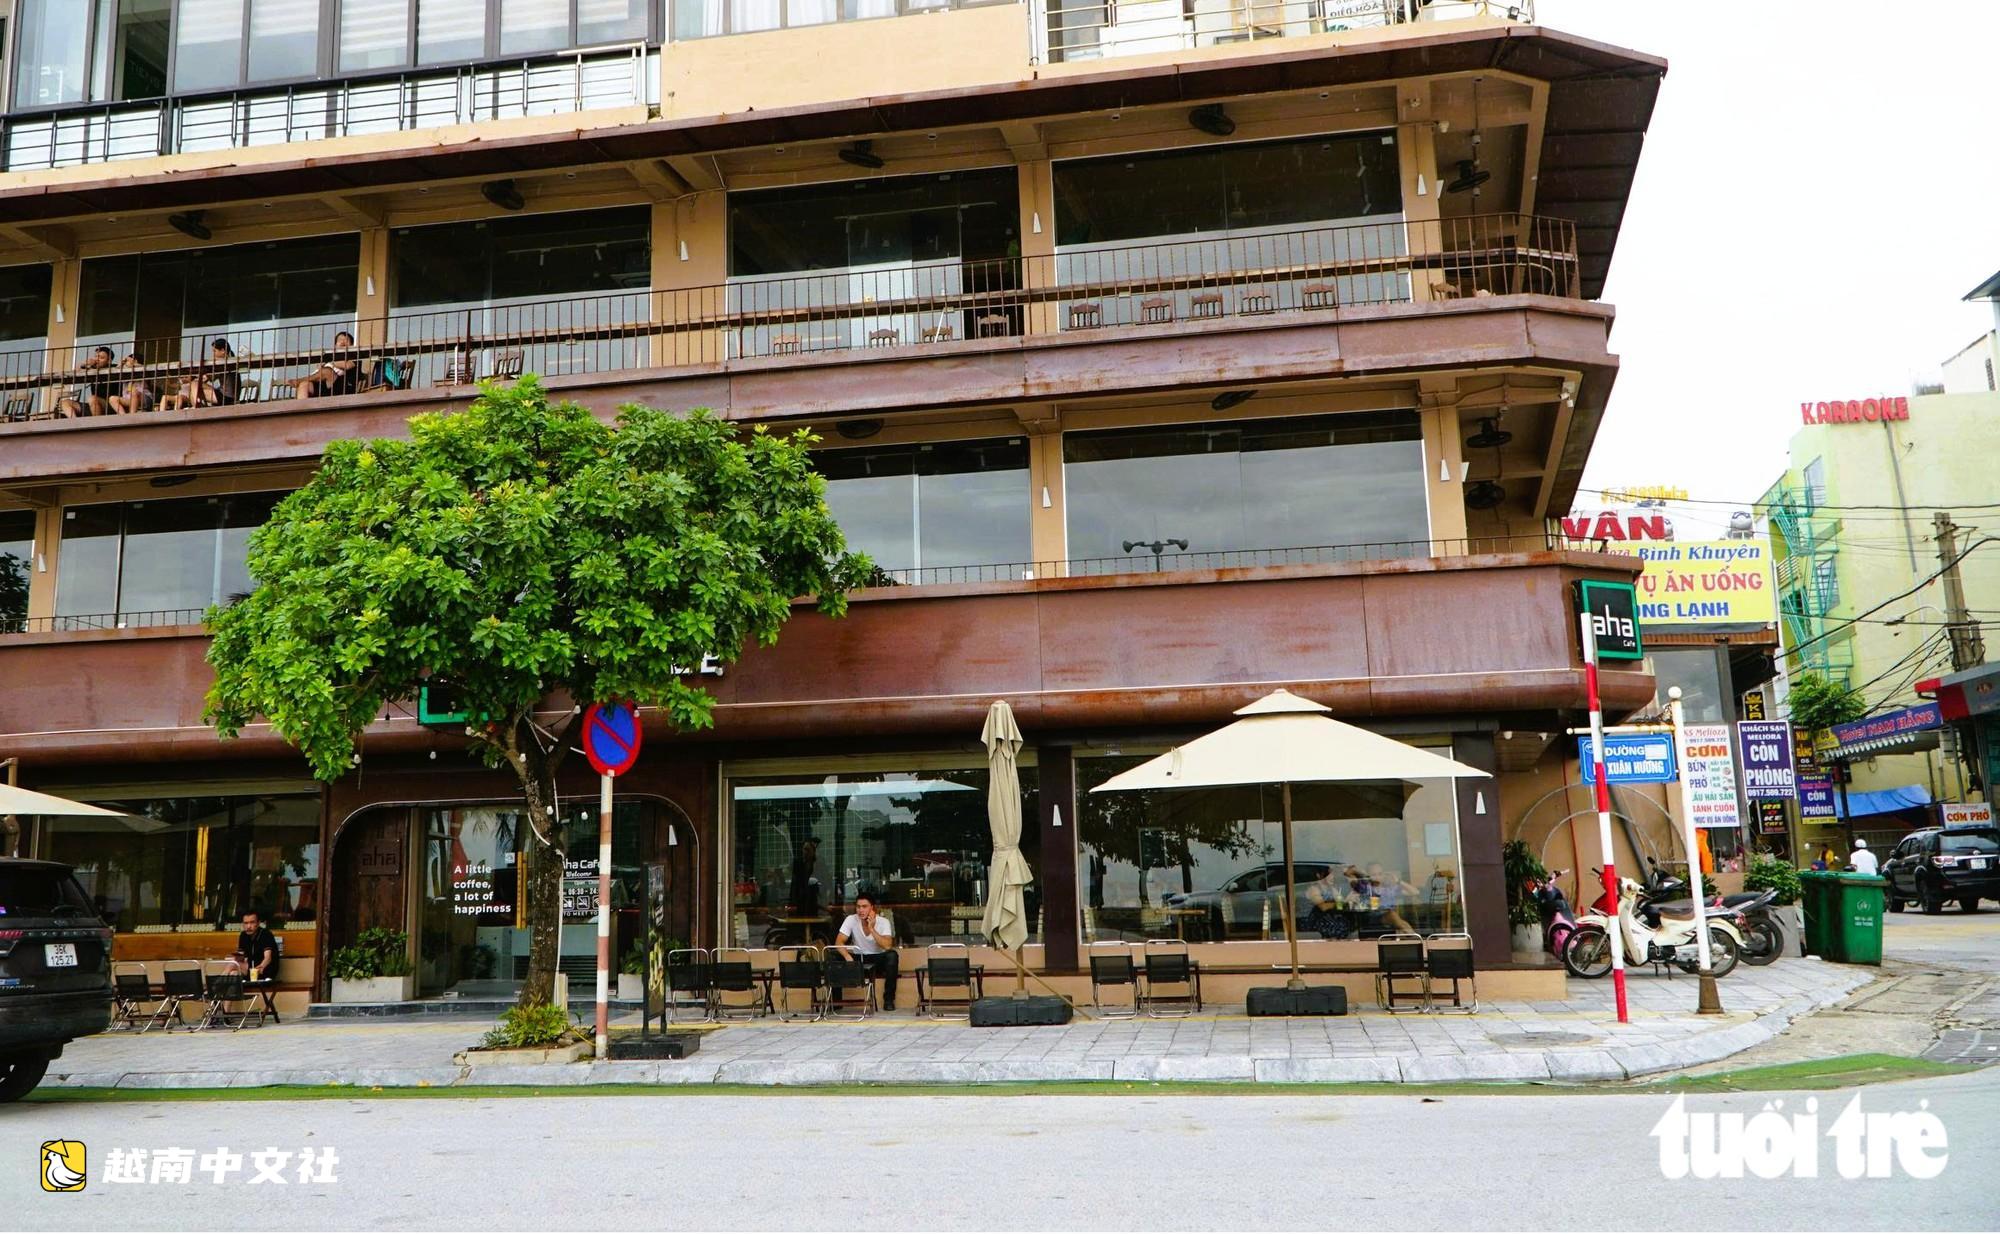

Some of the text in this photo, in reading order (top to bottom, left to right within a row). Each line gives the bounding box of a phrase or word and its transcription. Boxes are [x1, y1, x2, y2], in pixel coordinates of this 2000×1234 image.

[1801, 397, 1909, 425] KARAOKE
[1561, 511, 1665, 541] VÂN
[1688, 544, 1760, 562] Khuyên
[1664, 570, 1694, 592] ĂN
[1701, 565, 1763, 592] UỐNG
[1637, 602, 1729, 620] NG LẠNH
[1592, 604, 1635, 638] aha
[1770, 725, 1786, 733] SẠN
[1686, 744, 1728, 757] CƠM
[1750, 741, 1779, 761] CÒN
[1607, 759, 1632, 775] XUÂN
[1687, 760, 1706, 773] BÚN
[1746, 765, 1793, 786] PHÒNG
[1807, 790, 1826, 801] CÒN
[1803, 804, 1834, 816] PHÒNG
[1946, 811, 1968, 822] CƠM
[362, 847, 396, 866] aha
[454, 864, 492, 874] A little
[453, 880, 492, 890] coffee,
[454, 891, 494, 901] a lot of
[454, 904, 512, 915] happiness
